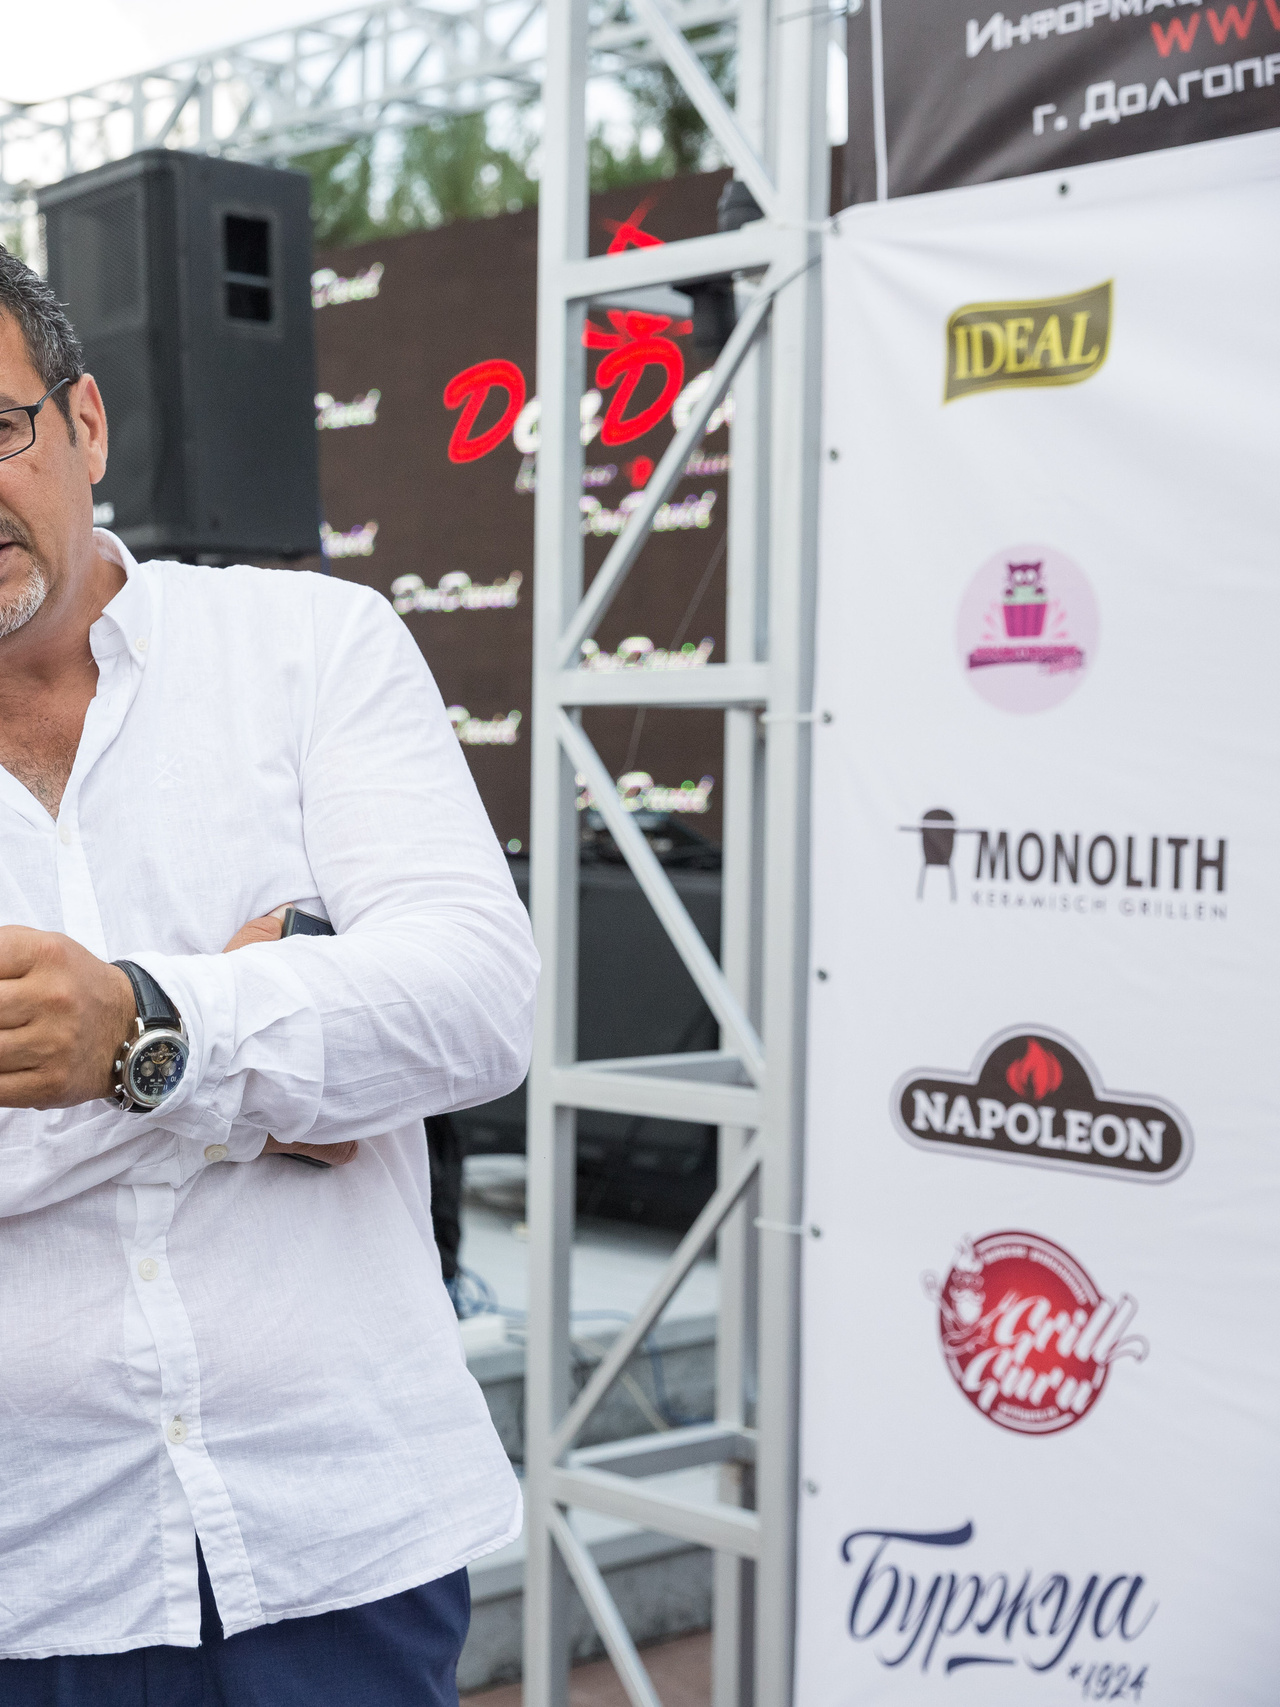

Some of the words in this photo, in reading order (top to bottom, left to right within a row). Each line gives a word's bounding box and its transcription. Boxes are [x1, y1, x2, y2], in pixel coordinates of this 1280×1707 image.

[952, 311, 1101, 380] IDEAL
[973, 829, 1227, 892] MONOLITH
[911, 1088, 1167, 1164] NAPOLEON
[994, 1292, 1150, 1366] Grill
[962, 1344, 1094, 1414] Guru
[840, 1519, 1160, 1674] Буржуа
